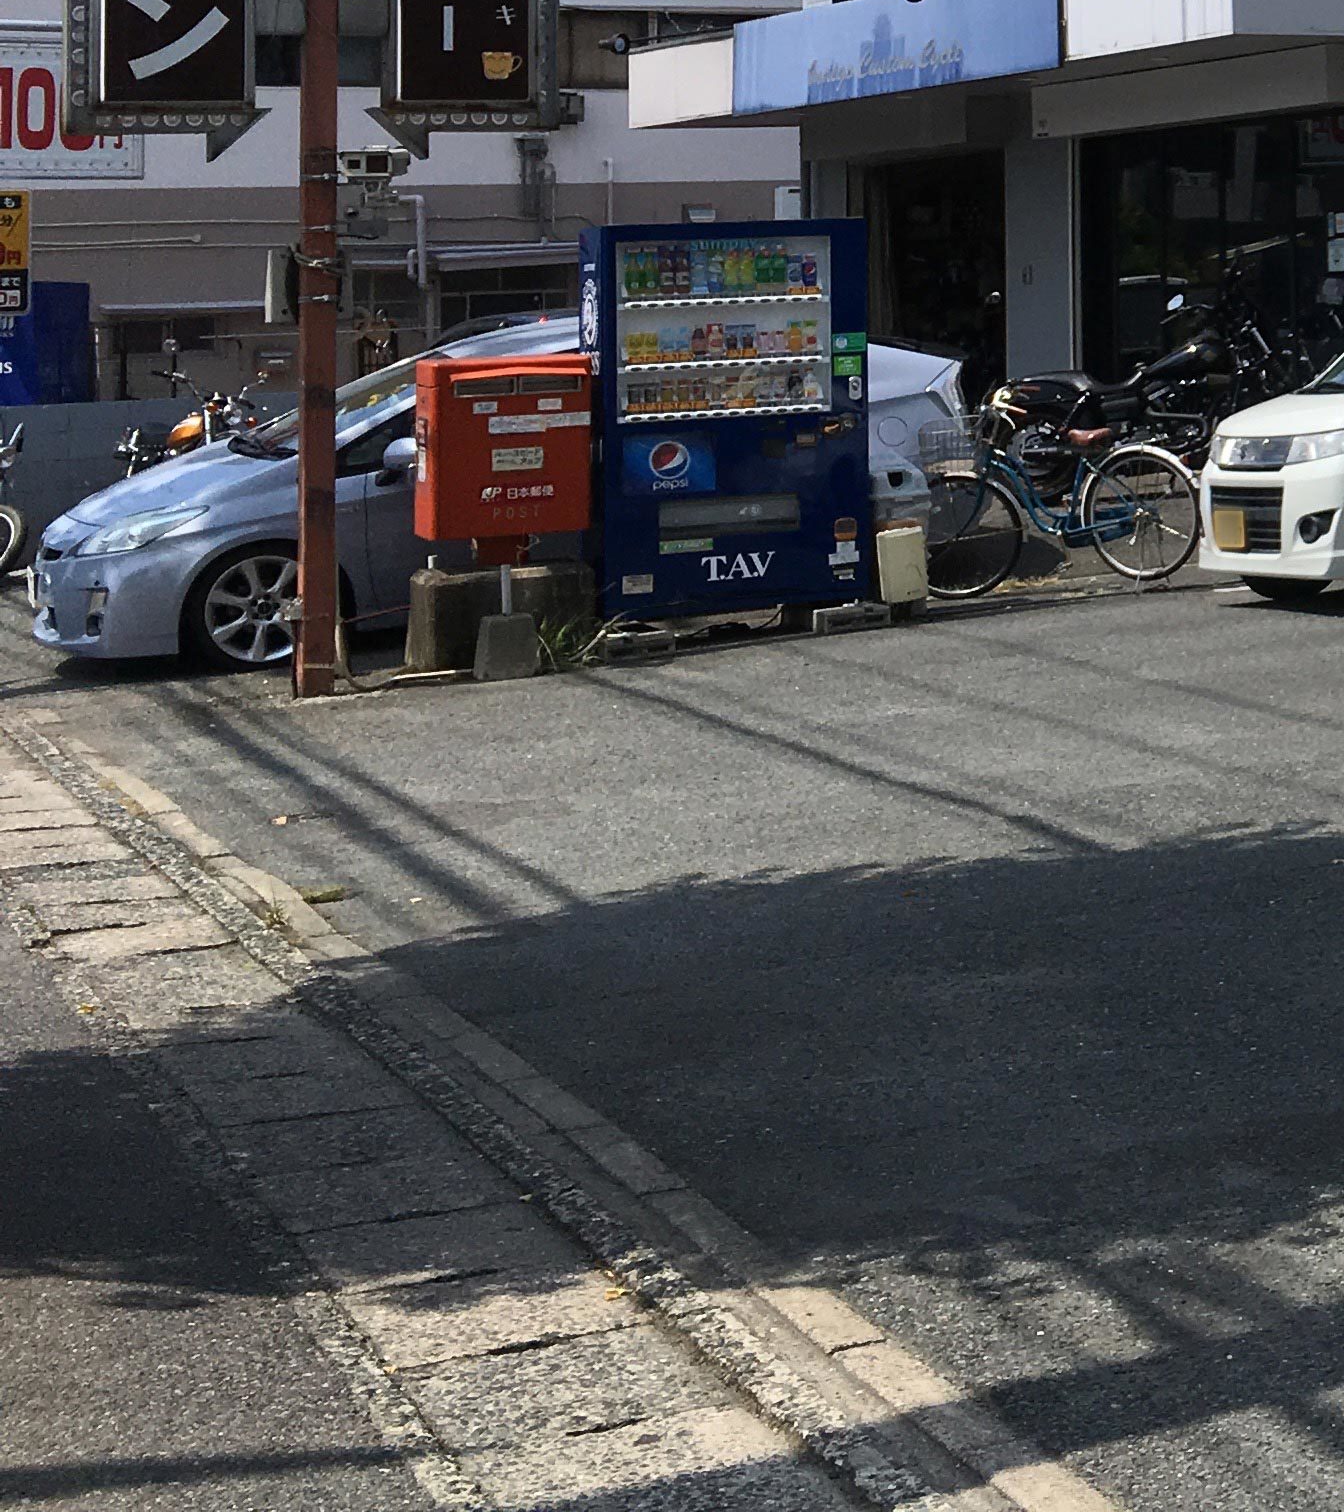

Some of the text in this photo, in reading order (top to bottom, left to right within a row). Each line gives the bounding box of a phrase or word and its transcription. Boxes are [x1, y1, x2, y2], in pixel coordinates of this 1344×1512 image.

[652, 477, 689, 491] pepsi
[507, 484, 554, 500] 日本郵便
[492, 506, 541, 521] POST
